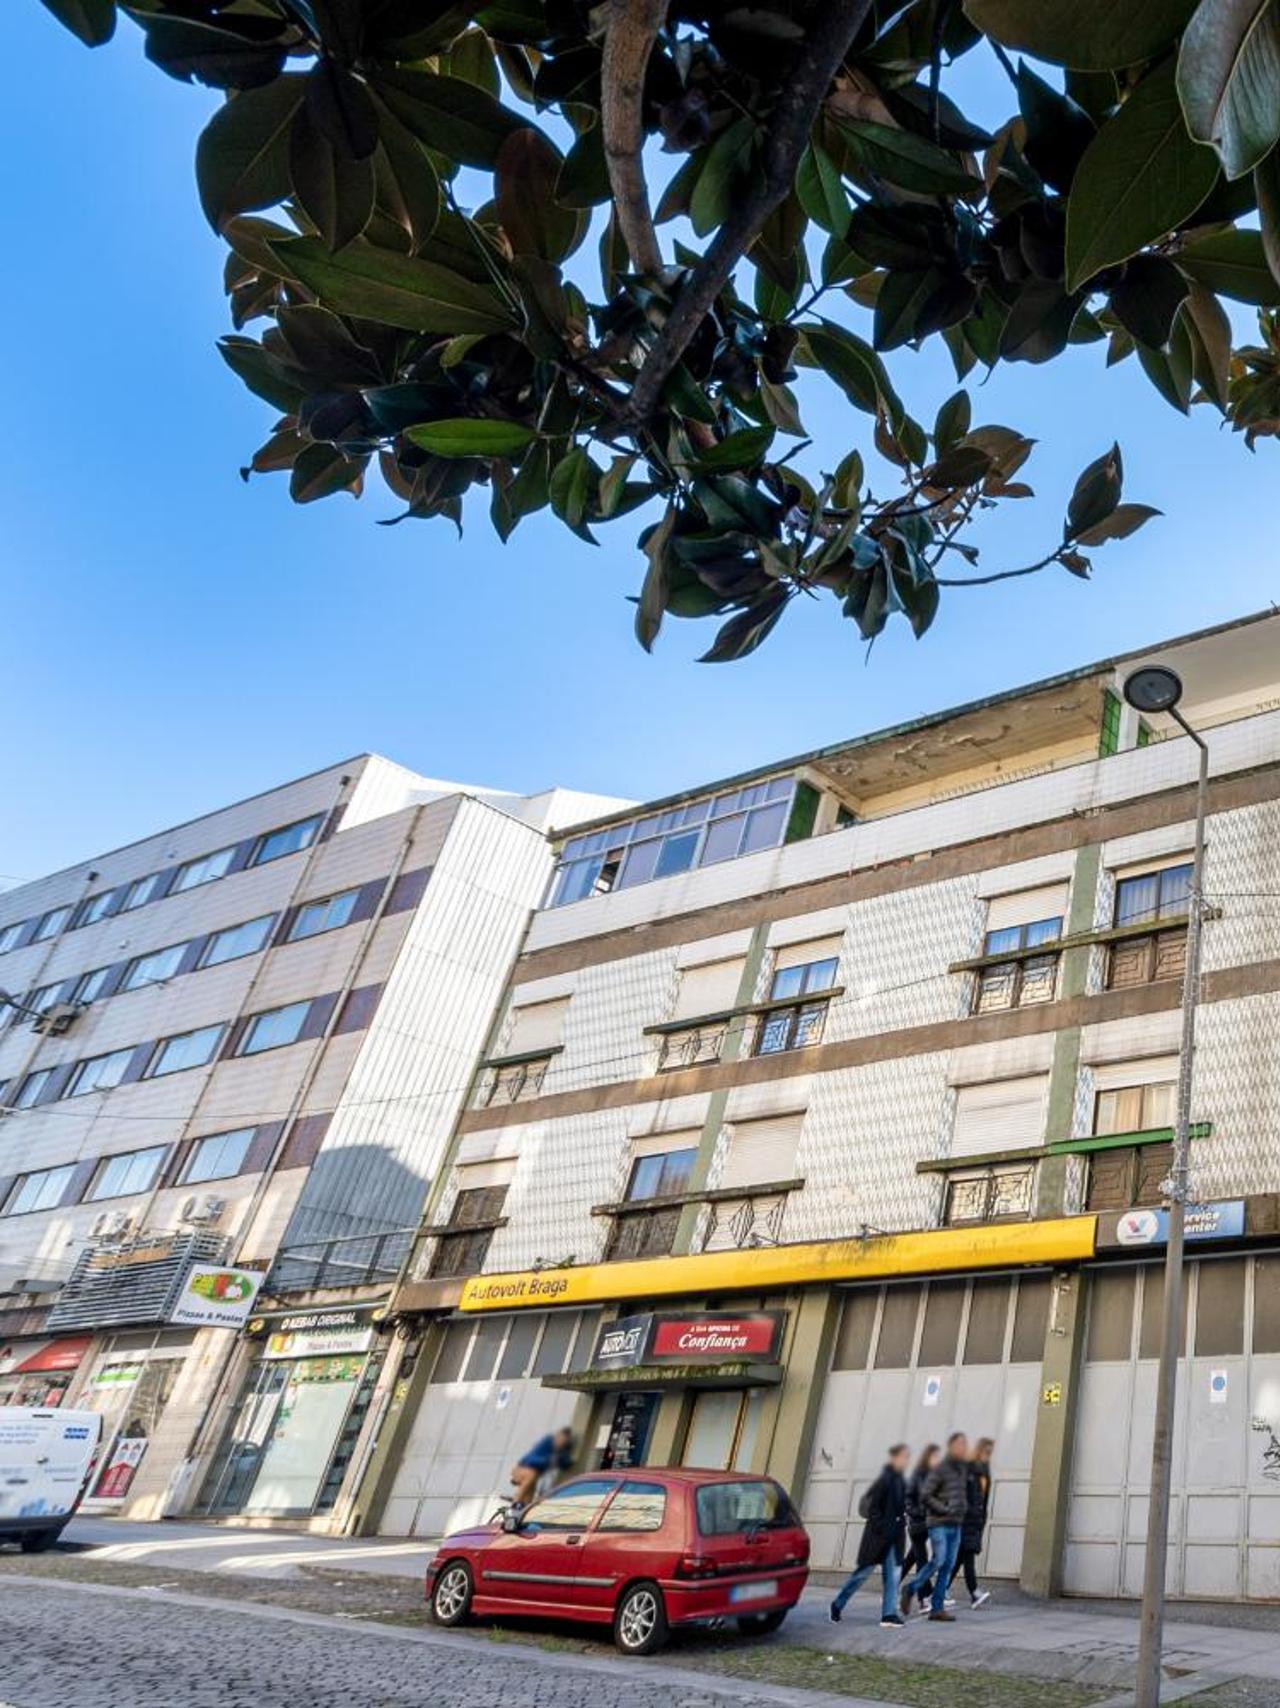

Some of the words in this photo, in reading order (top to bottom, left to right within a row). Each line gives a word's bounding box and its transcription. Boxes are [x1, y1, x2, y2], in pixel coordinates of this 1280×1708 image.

[1184, 1211, 1220, 1223] ervice
[1184, 1222, 1217, 1233] enter
[468, 1280, 526, 1300] Autovolt
[529, 1279, 569, 1297] Braga
[679, 1333, 747, 1350] Confiança
